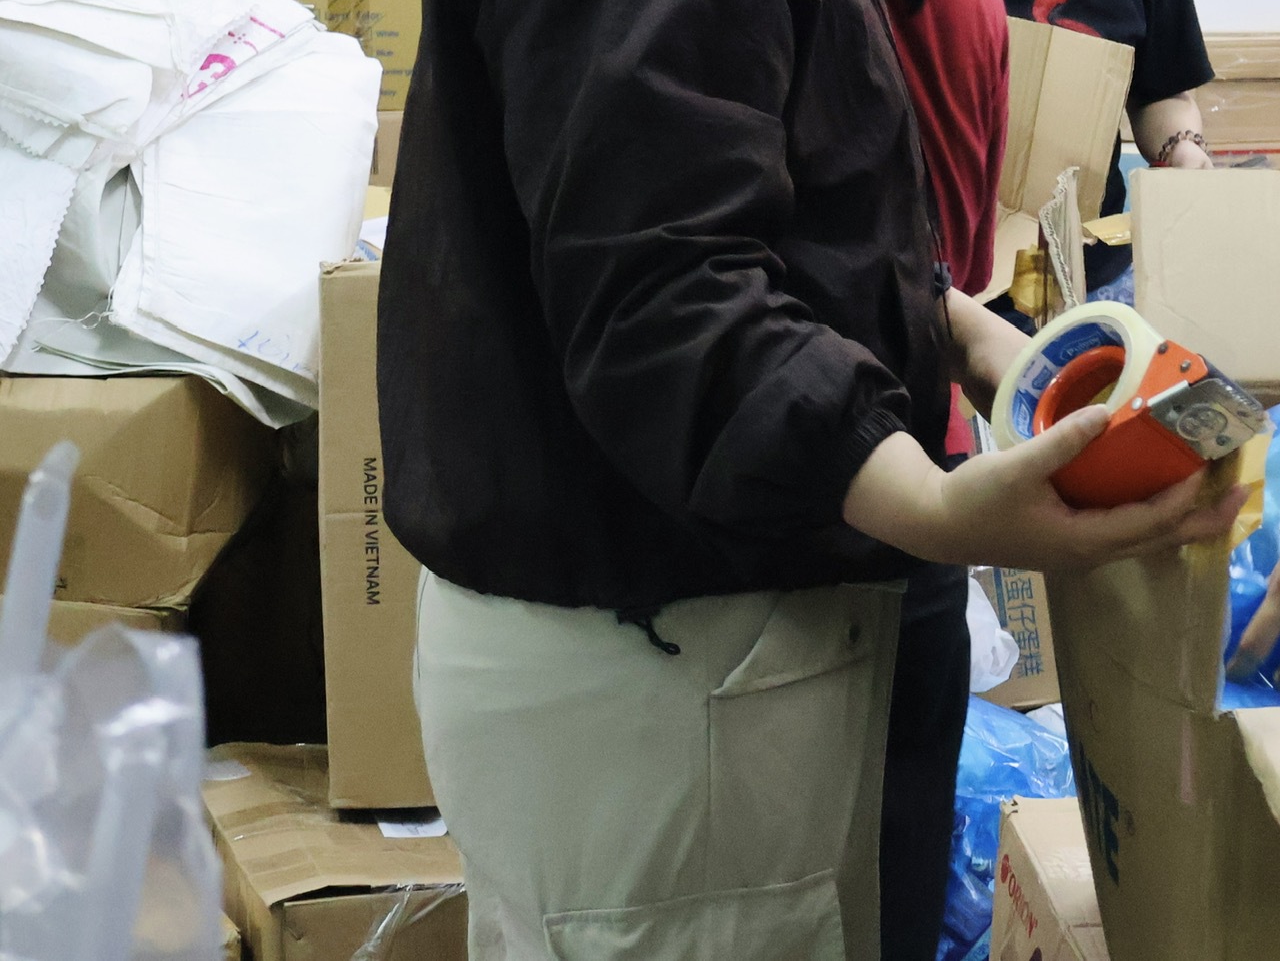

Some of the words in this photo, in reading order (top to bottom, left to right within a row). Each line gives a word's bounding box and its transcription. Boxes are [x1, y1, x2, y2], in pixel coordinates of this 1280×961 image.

[363, 457, 378, 505] MADE
[365, 510, 378, 526] IN
[365, 529, 380, 606] VIETNAM
